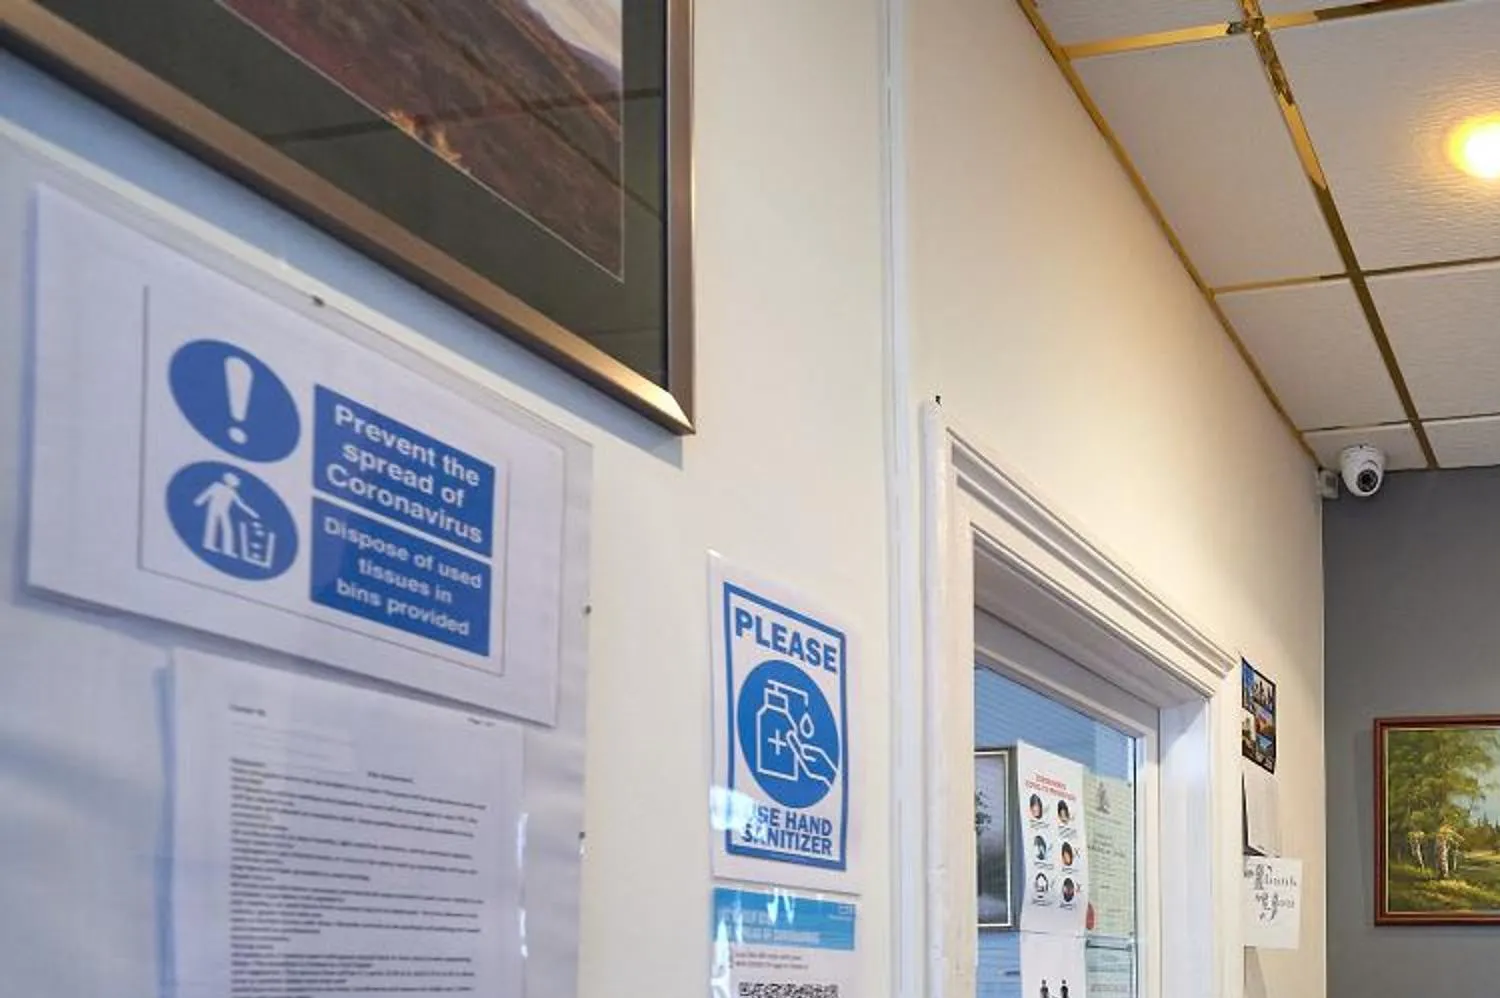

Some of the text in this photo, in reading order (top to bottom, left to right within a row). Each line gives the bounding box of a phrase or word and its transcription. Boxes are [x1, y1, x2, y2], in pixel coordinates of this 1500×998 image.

[335, 404, 480, 486] Prevent the
[343, 444, 464, 508] spread of
[327, 463, 482, 543] Coronavirus
[324, 517, 482, 589] Dispose of used
[359, 558, 452, 603] tissues in
[337, 578, 470, 636] bins provided
[735, 607, 837, 673] PLEASE
[752, 804, 833, 837] SE HAND
